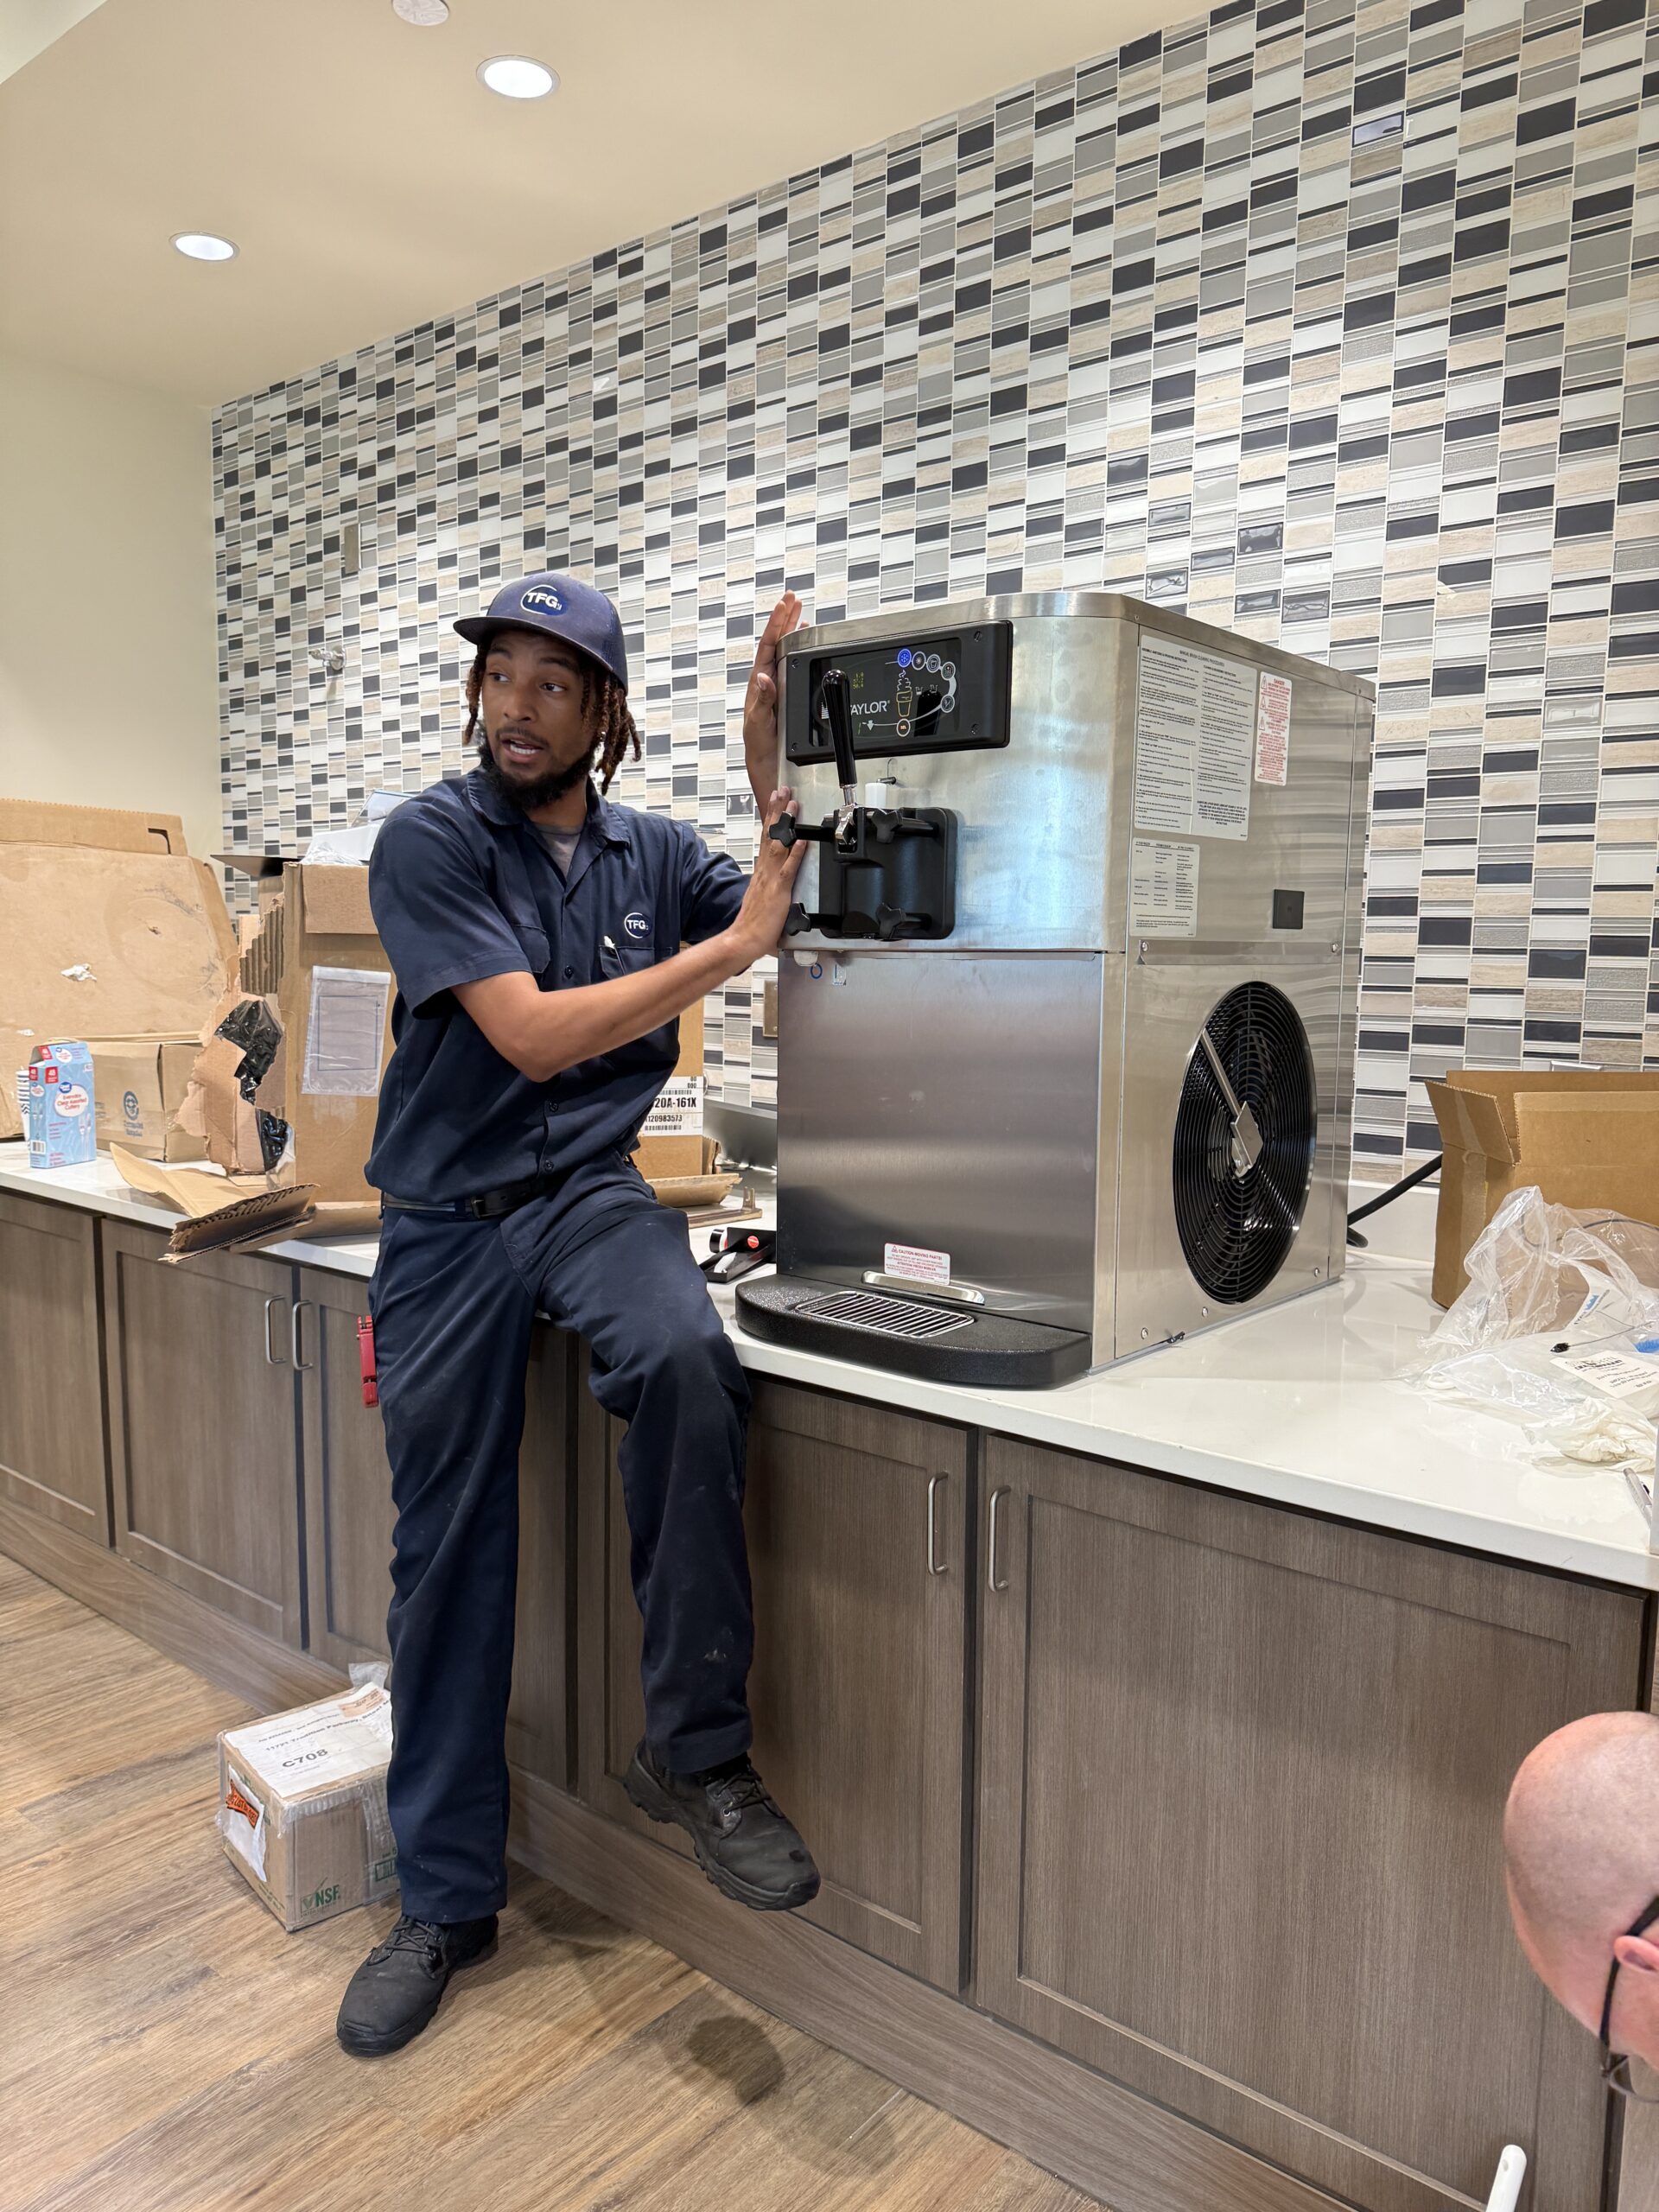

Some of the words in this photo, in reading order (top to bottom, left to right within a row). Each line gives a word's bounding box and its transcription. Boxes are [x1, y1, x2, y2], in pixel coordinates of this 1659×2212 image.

[527, 592, 558, 608] TFG
[849, 701, 887, 715] AYLOR
[626, 919, 645, 930] TFG
[654, 1097, 696, 1108] 20A-161X
[282, 1749, 328, 1768] C708
[315, 1884, 340, 1907] NSF
